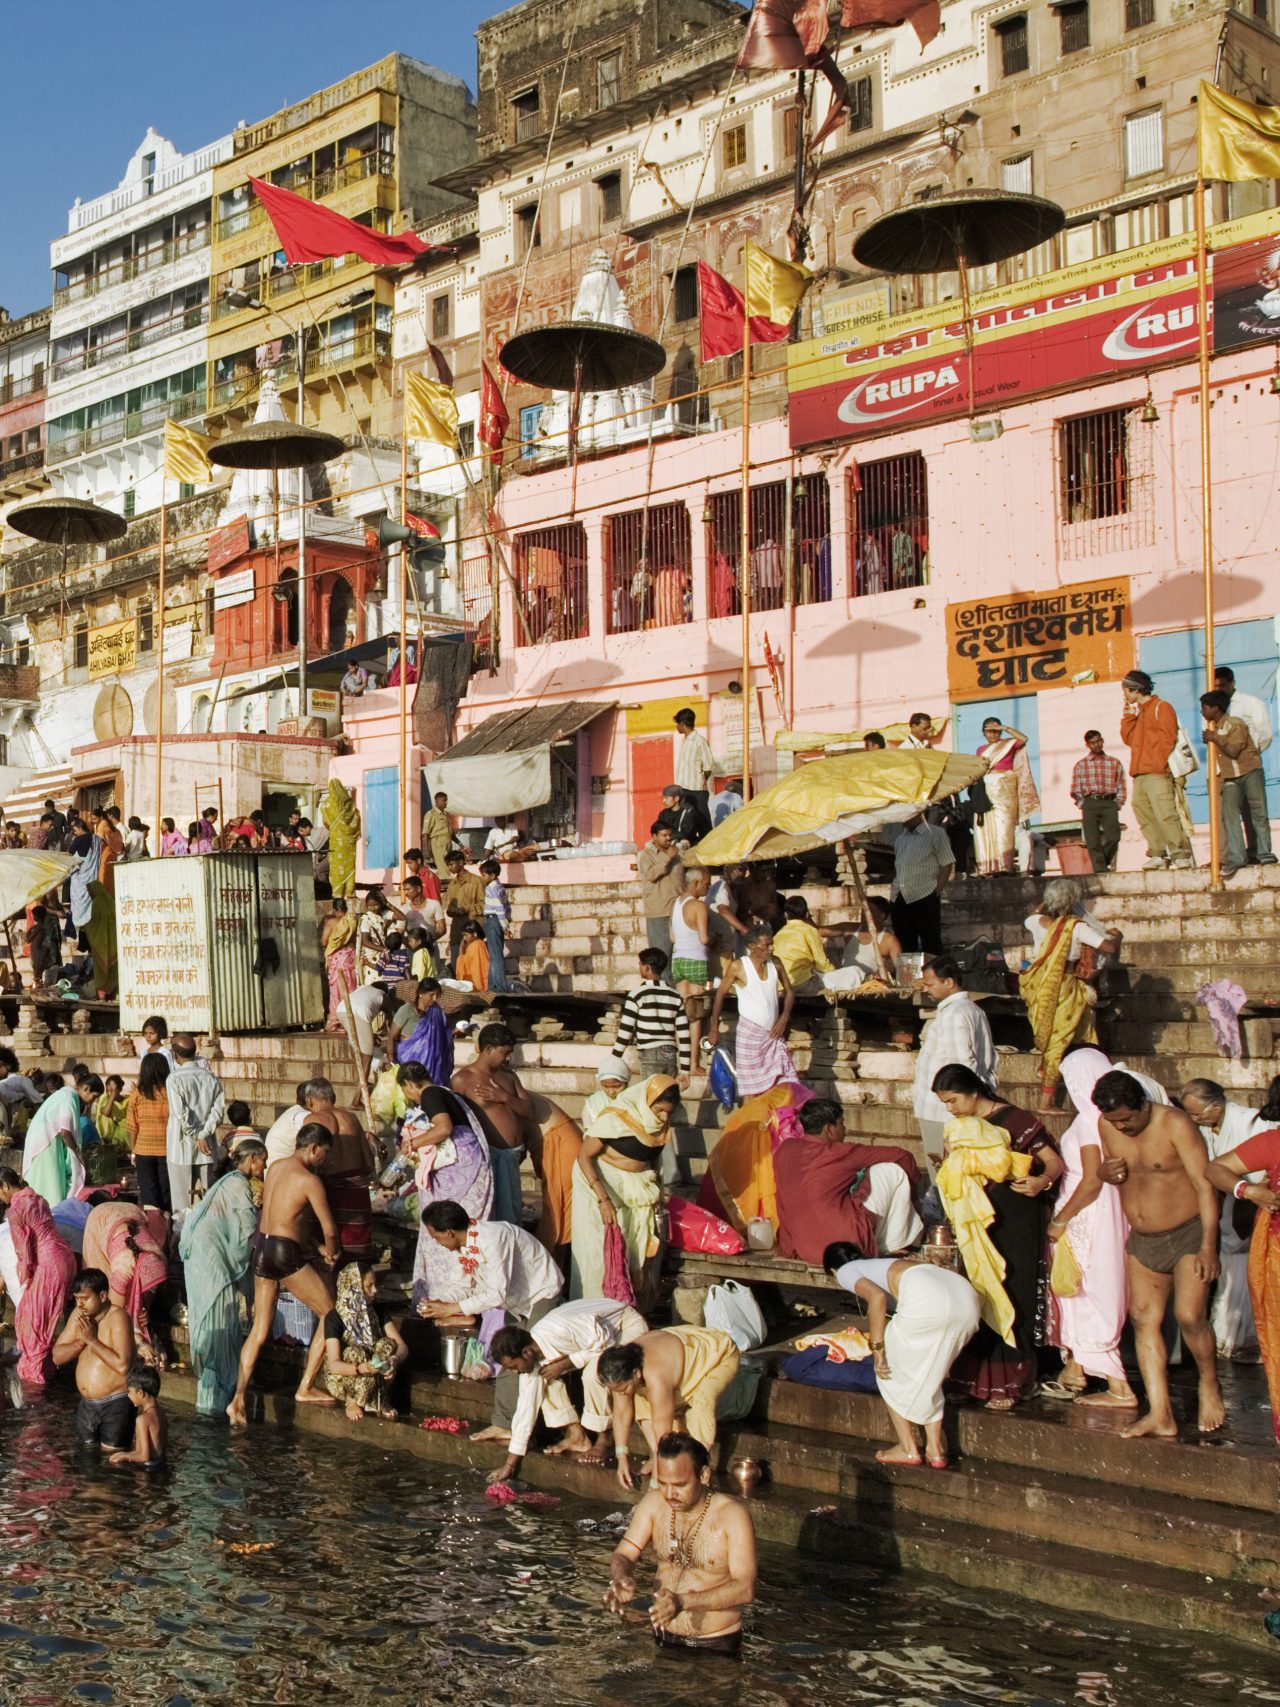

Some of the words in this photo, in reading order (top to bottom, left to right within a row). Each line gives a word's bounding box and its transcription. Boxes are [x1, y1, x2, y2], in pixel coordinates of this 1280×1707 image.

[824, 292, 886, 322] FRIEND'S
[825, 320, 851, 334] GUEST
[852, 310, 885, 326] HOUSE
[865, 365, 960, 406] RUPA
[933, 396, 955, 408] Inner
[956, 393, 964, 402] &
[997, 380, 1021, 392] Wear
[1031, 595, 1066, 615] माता
[955, 604, 1126, 658] दशाश्वमेध
[89, 654, 117, 672] AHILYABAI
[117, 650, 135, 667] GHAT
[976, 647, 1069, 689] घाट
